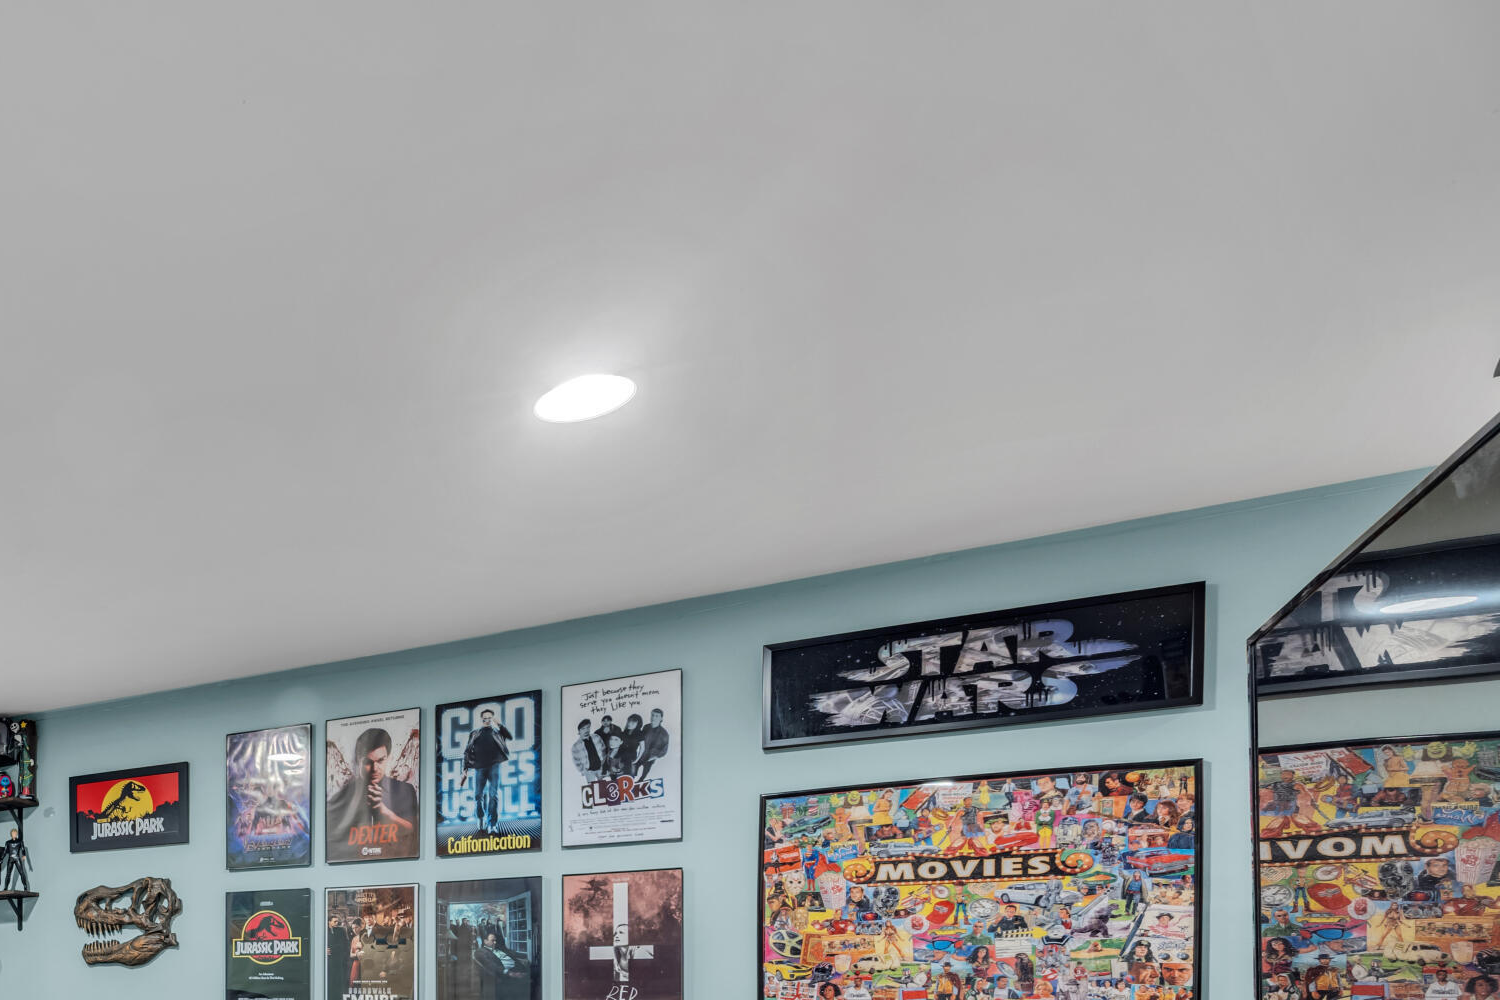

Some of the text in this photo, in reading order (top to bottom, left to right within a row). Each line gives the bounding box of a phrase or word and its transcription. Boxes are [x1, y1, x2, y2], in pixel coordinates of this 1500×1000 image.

[837, 619, 1138, 682] STAR
[809, 655, 1141, 727] WARS
[442, 751, 535, 792] HES
[499, 784, 535, 815] LL
[91, 817, 164, 840] JURASSIC PARK
[348, 822, 398, 845] DEXTER
[447, 834, 531, 855] Californication
[876, 855, 1051, 882] MOVIES
[235, 940, 299, 955] JURASSIC PARK
